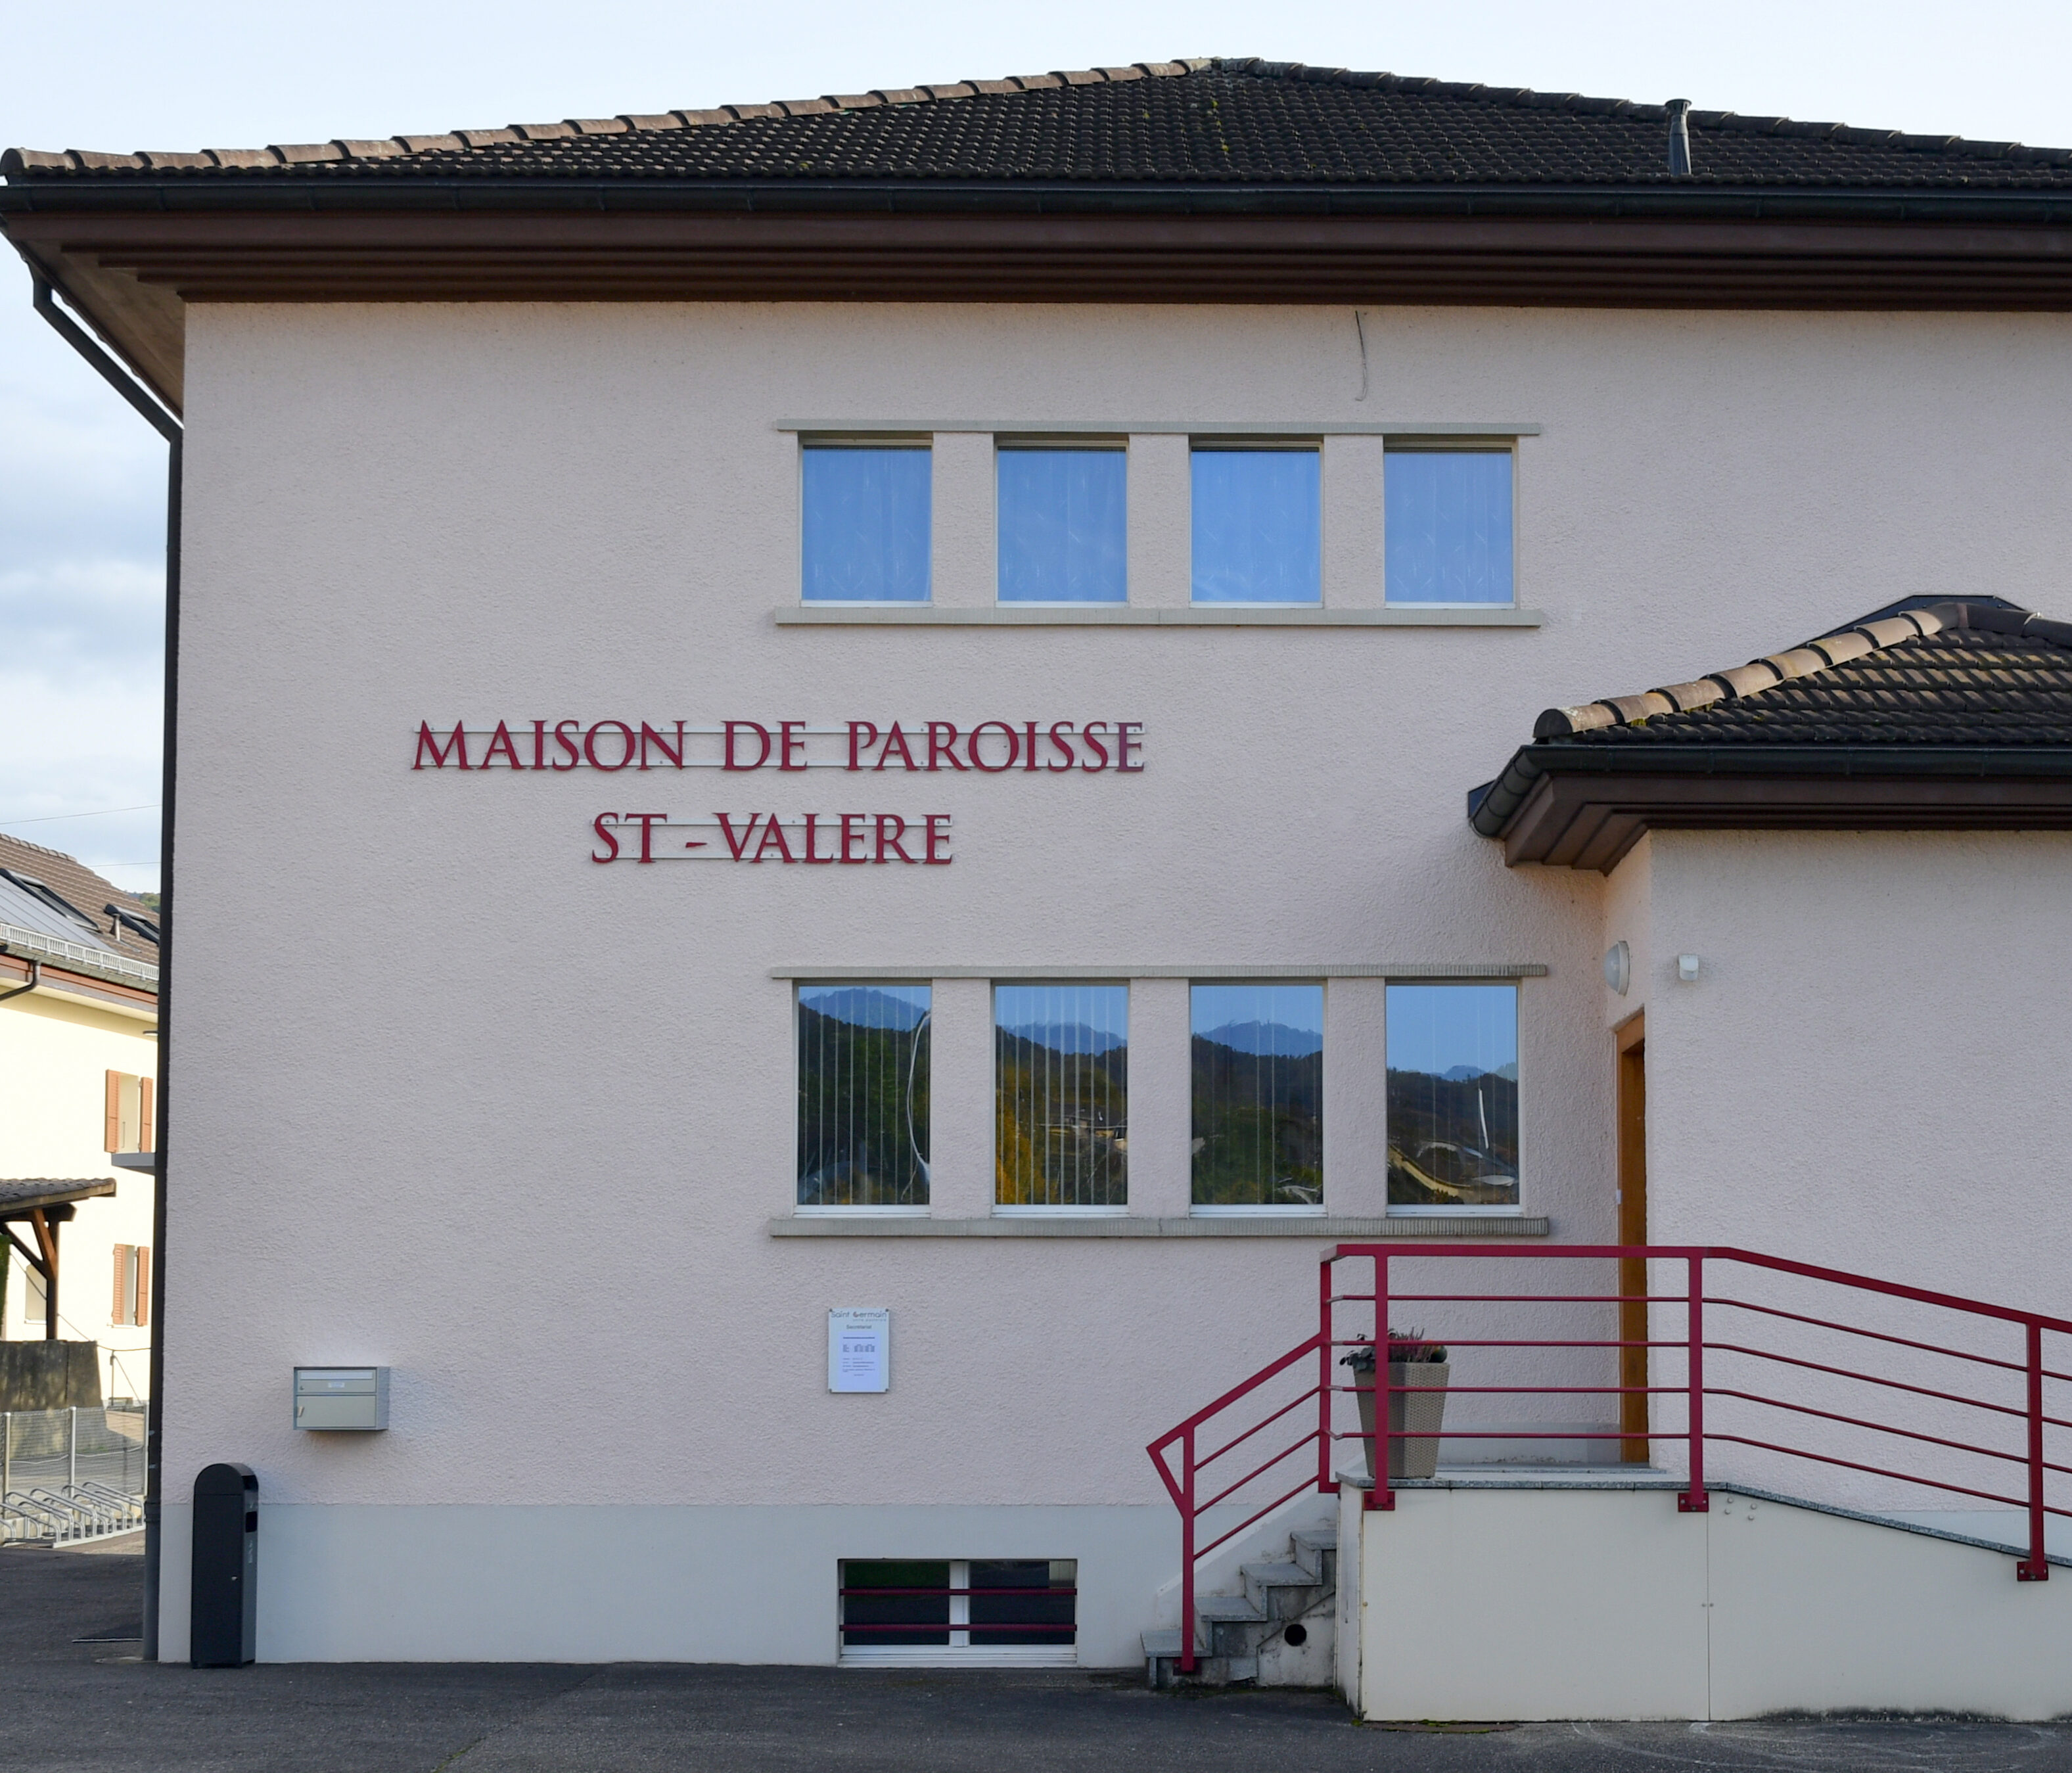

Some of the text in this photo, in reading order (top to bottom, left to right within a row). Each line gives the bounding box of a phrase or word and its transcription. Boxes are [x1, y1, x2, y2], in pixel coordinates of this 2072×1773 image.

[412, 720, 1145, 774] MAISON DE PAROISSE
